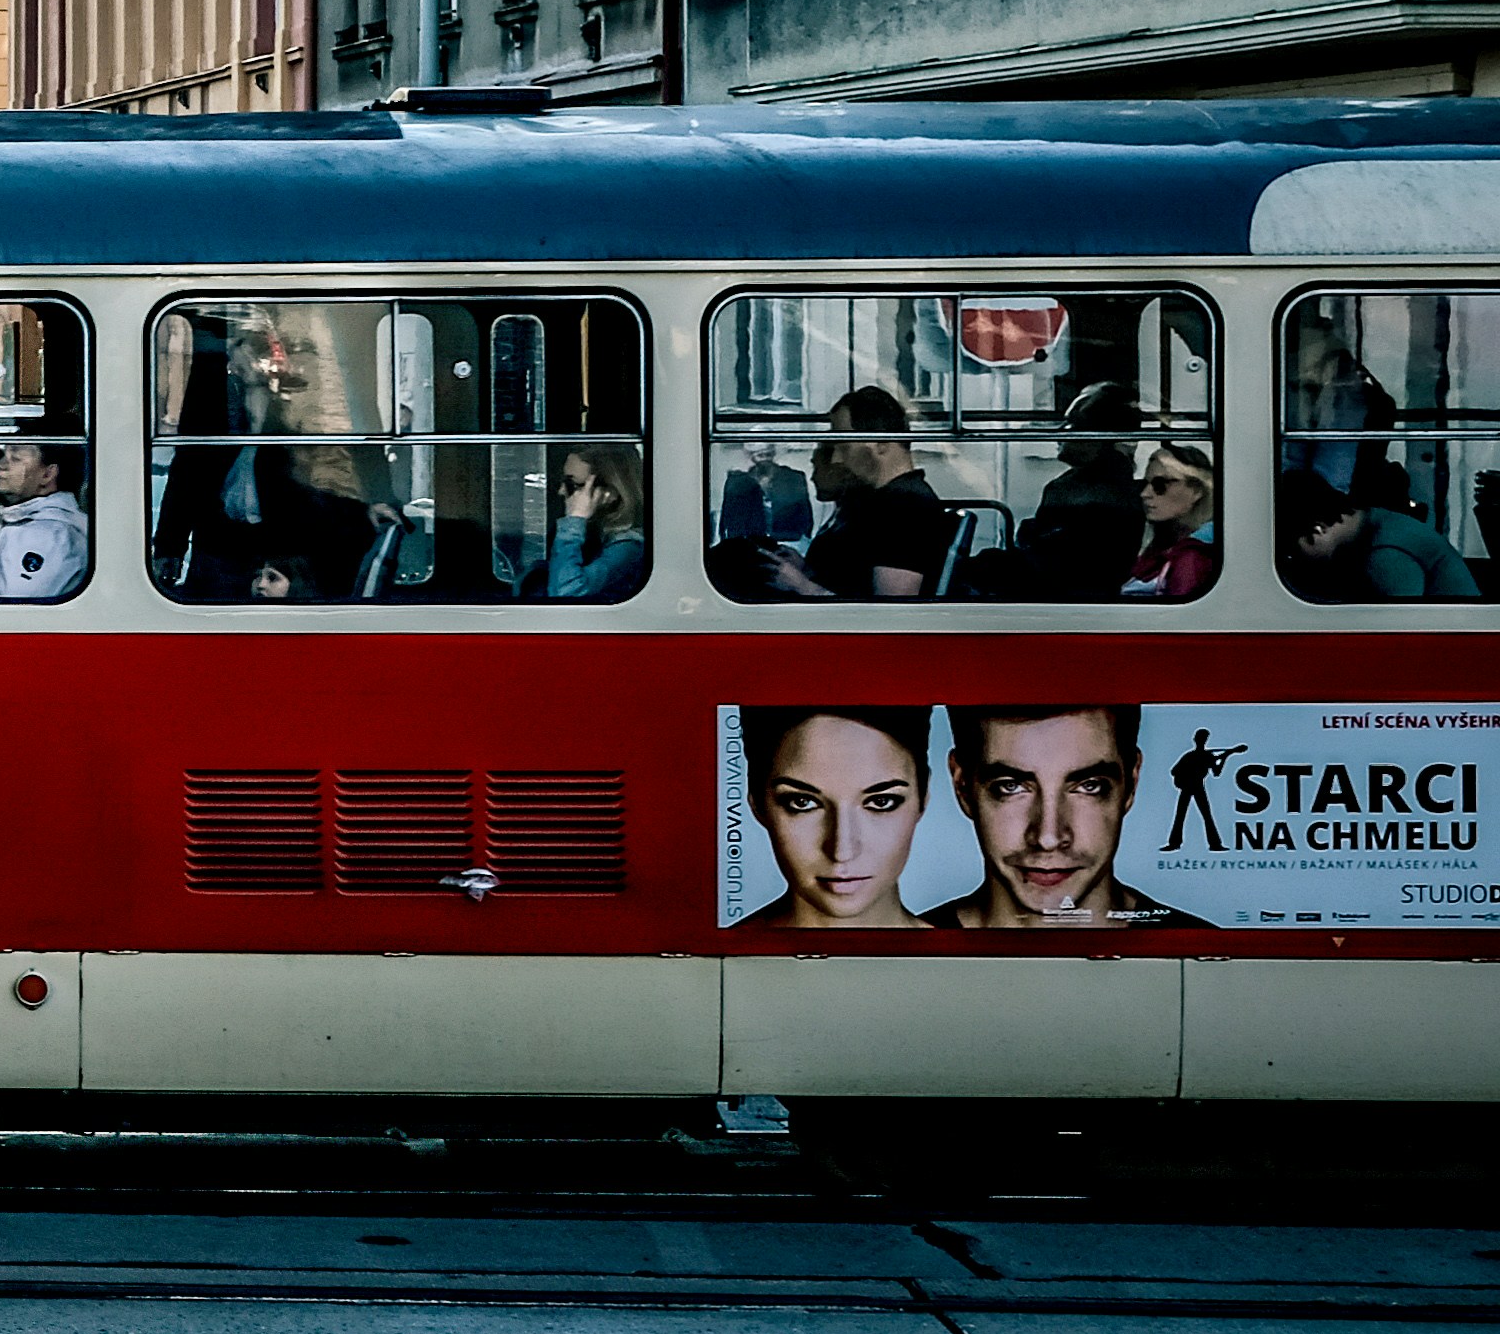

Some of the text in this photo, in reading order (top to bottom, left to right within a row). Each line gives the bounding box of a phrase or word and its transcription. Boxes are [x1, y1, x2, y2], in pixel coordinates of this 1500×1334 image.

[1322, 712, 1369, 729] LETNÍ
[1375, 712, 1430, 729] SCÉNA
[1235, 763, 1478, 815] STARCI
[1235, 821, 1478, 851] NA CHMELU
[1158, 858, 1208, 870] BLAŽEK
[1220, 860, 1287, 870] RYCHMAN
[1301, 858, 1353, 870] BAŽANT
[1367, 857, 1429, 870] MALÁSEK
[1443, 858, 1478, 870] HÁLA
